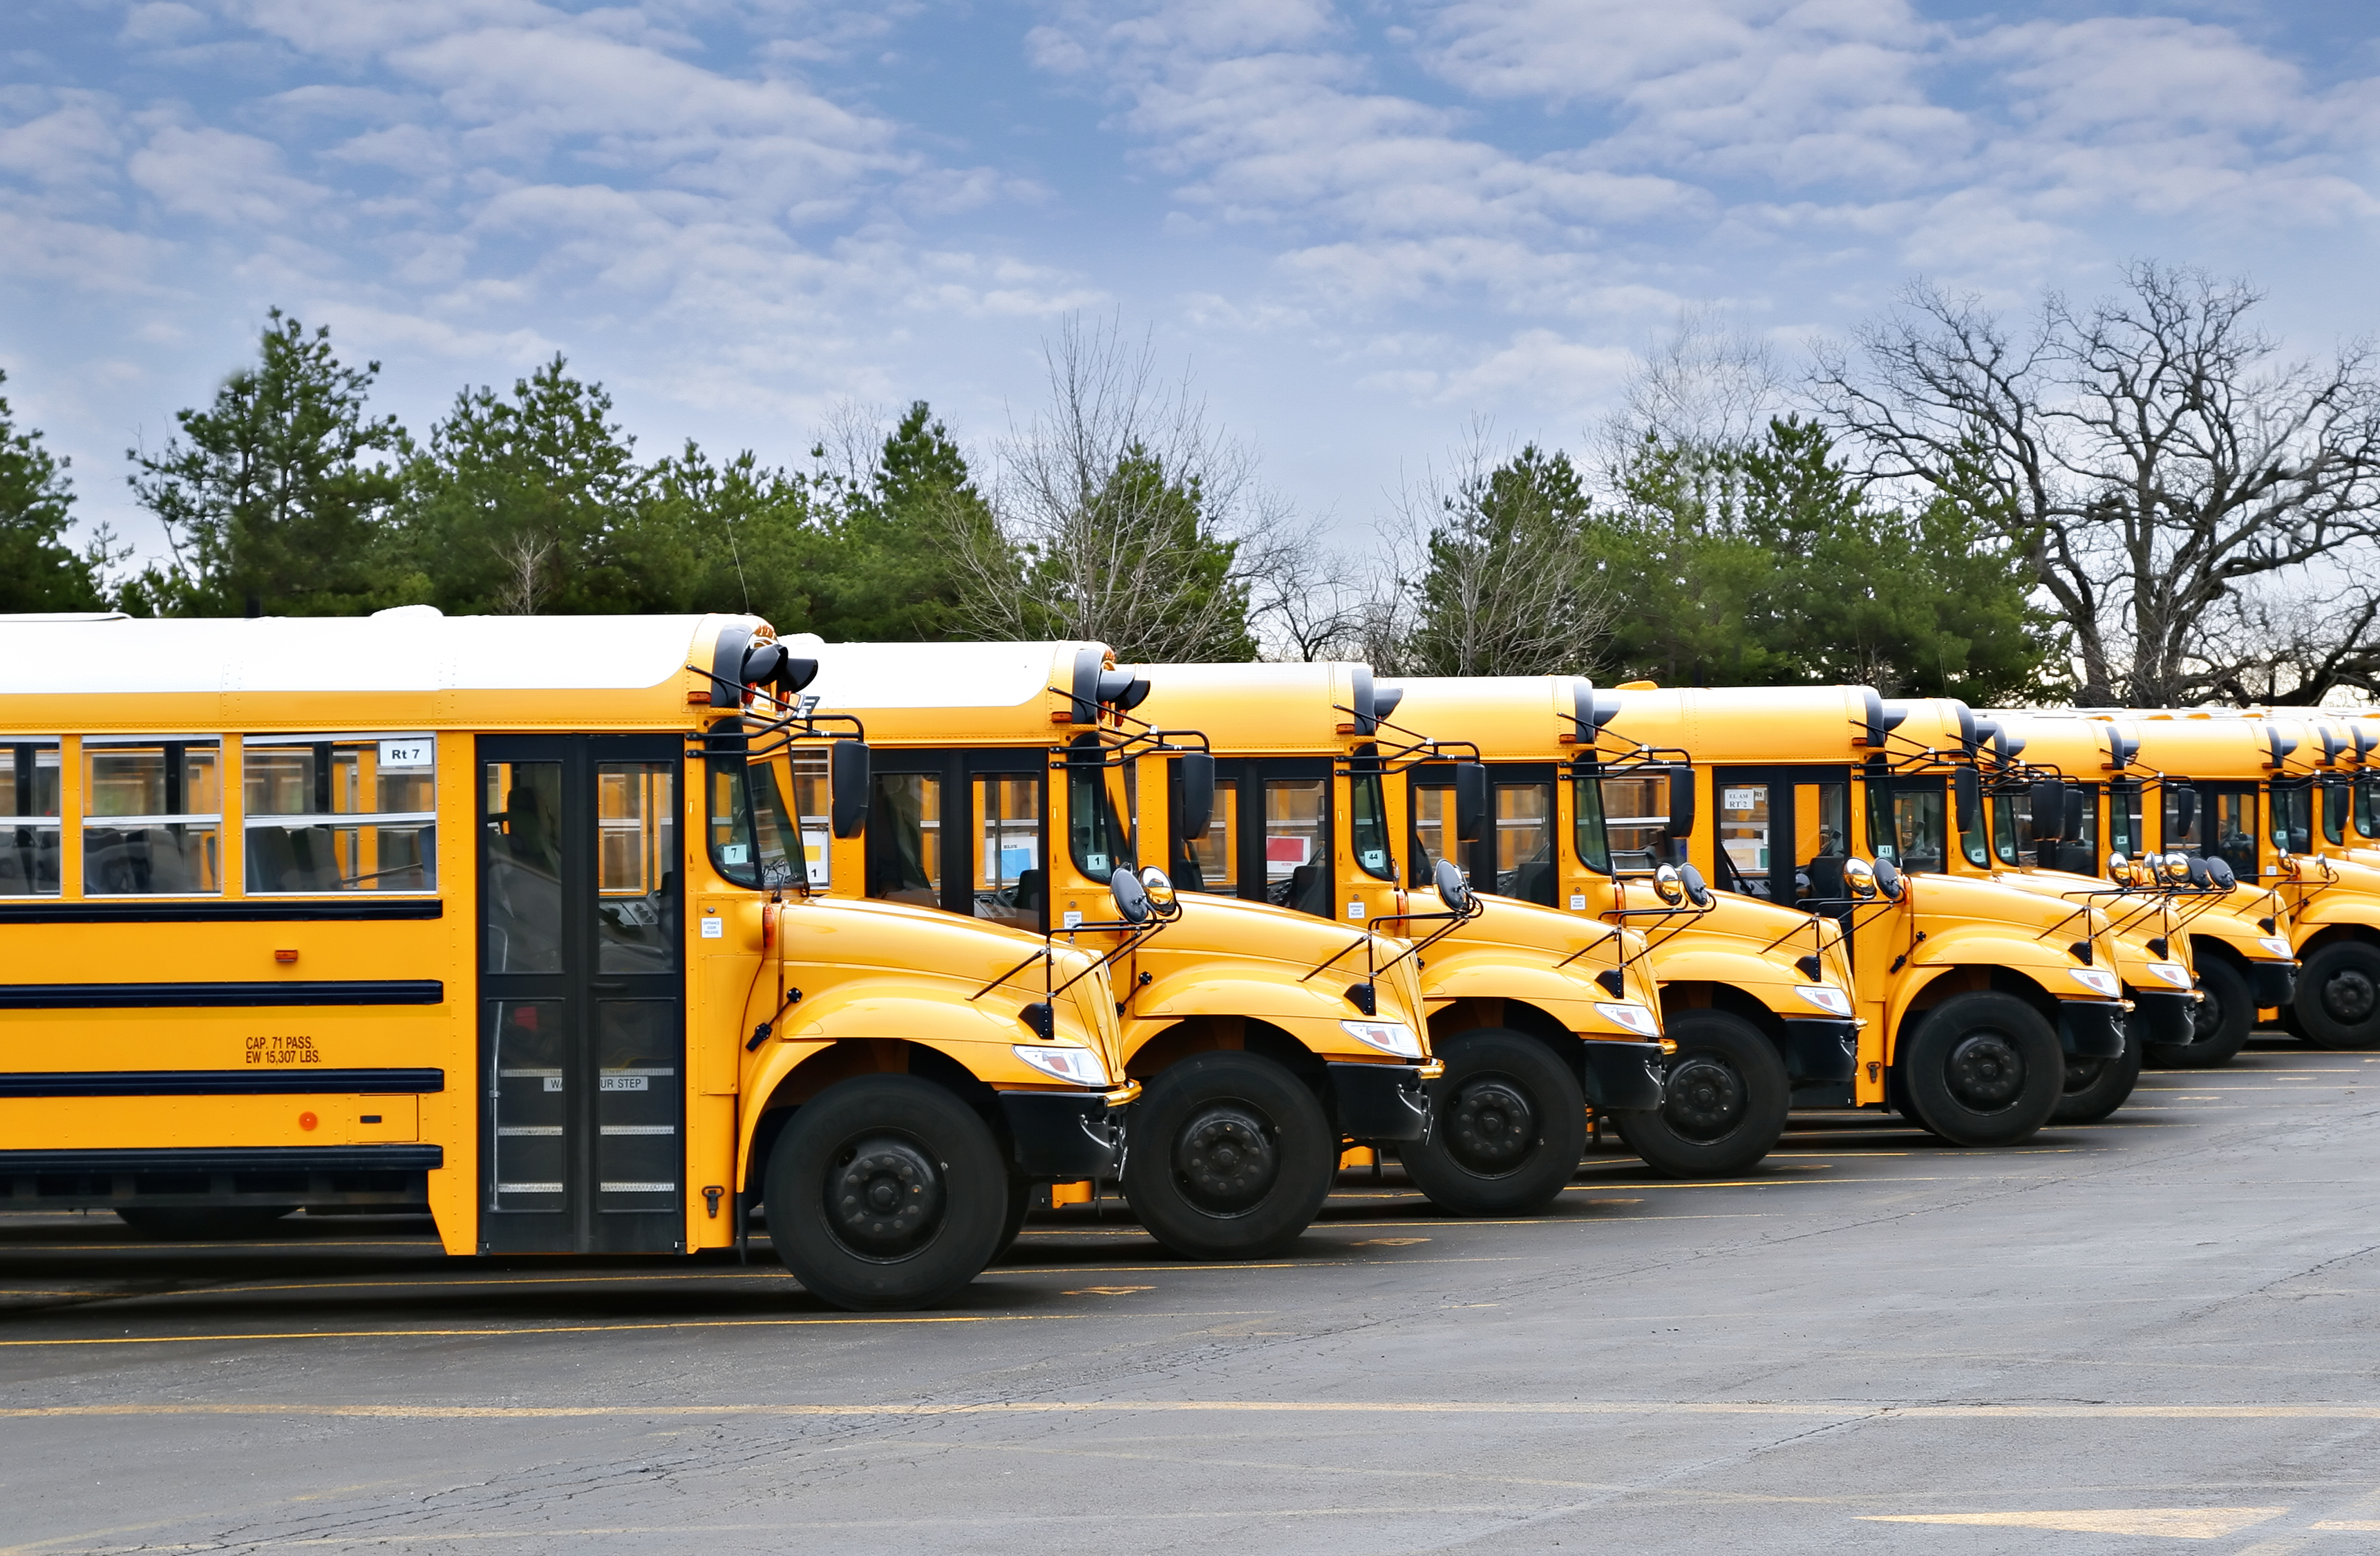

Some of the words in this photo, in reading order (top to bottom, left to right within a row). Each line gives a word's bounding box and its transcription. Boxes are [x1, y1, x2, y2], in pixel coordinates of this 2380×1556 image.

[392, 750, 407, 759] Rt
[412, 749, 420, 759] 7
[730, 847, 737, 859] 7
[1095, 856, 1100, 865] 1
[811, 868, 817, 878] 1
[246, 1037, 268, 1049] CAP.
[272, 1037, 282, 1049] 71
[286, 1036, 314, 1049] PASS.
[246, 1051, 261, 1063] EW
[265, 1050, 296, 1065] 15,307
[300, 1050, 321, 1062] LBS.
[601, 1080, 614, 1088] UR
[618, 1078, 641, 1088] STEP
